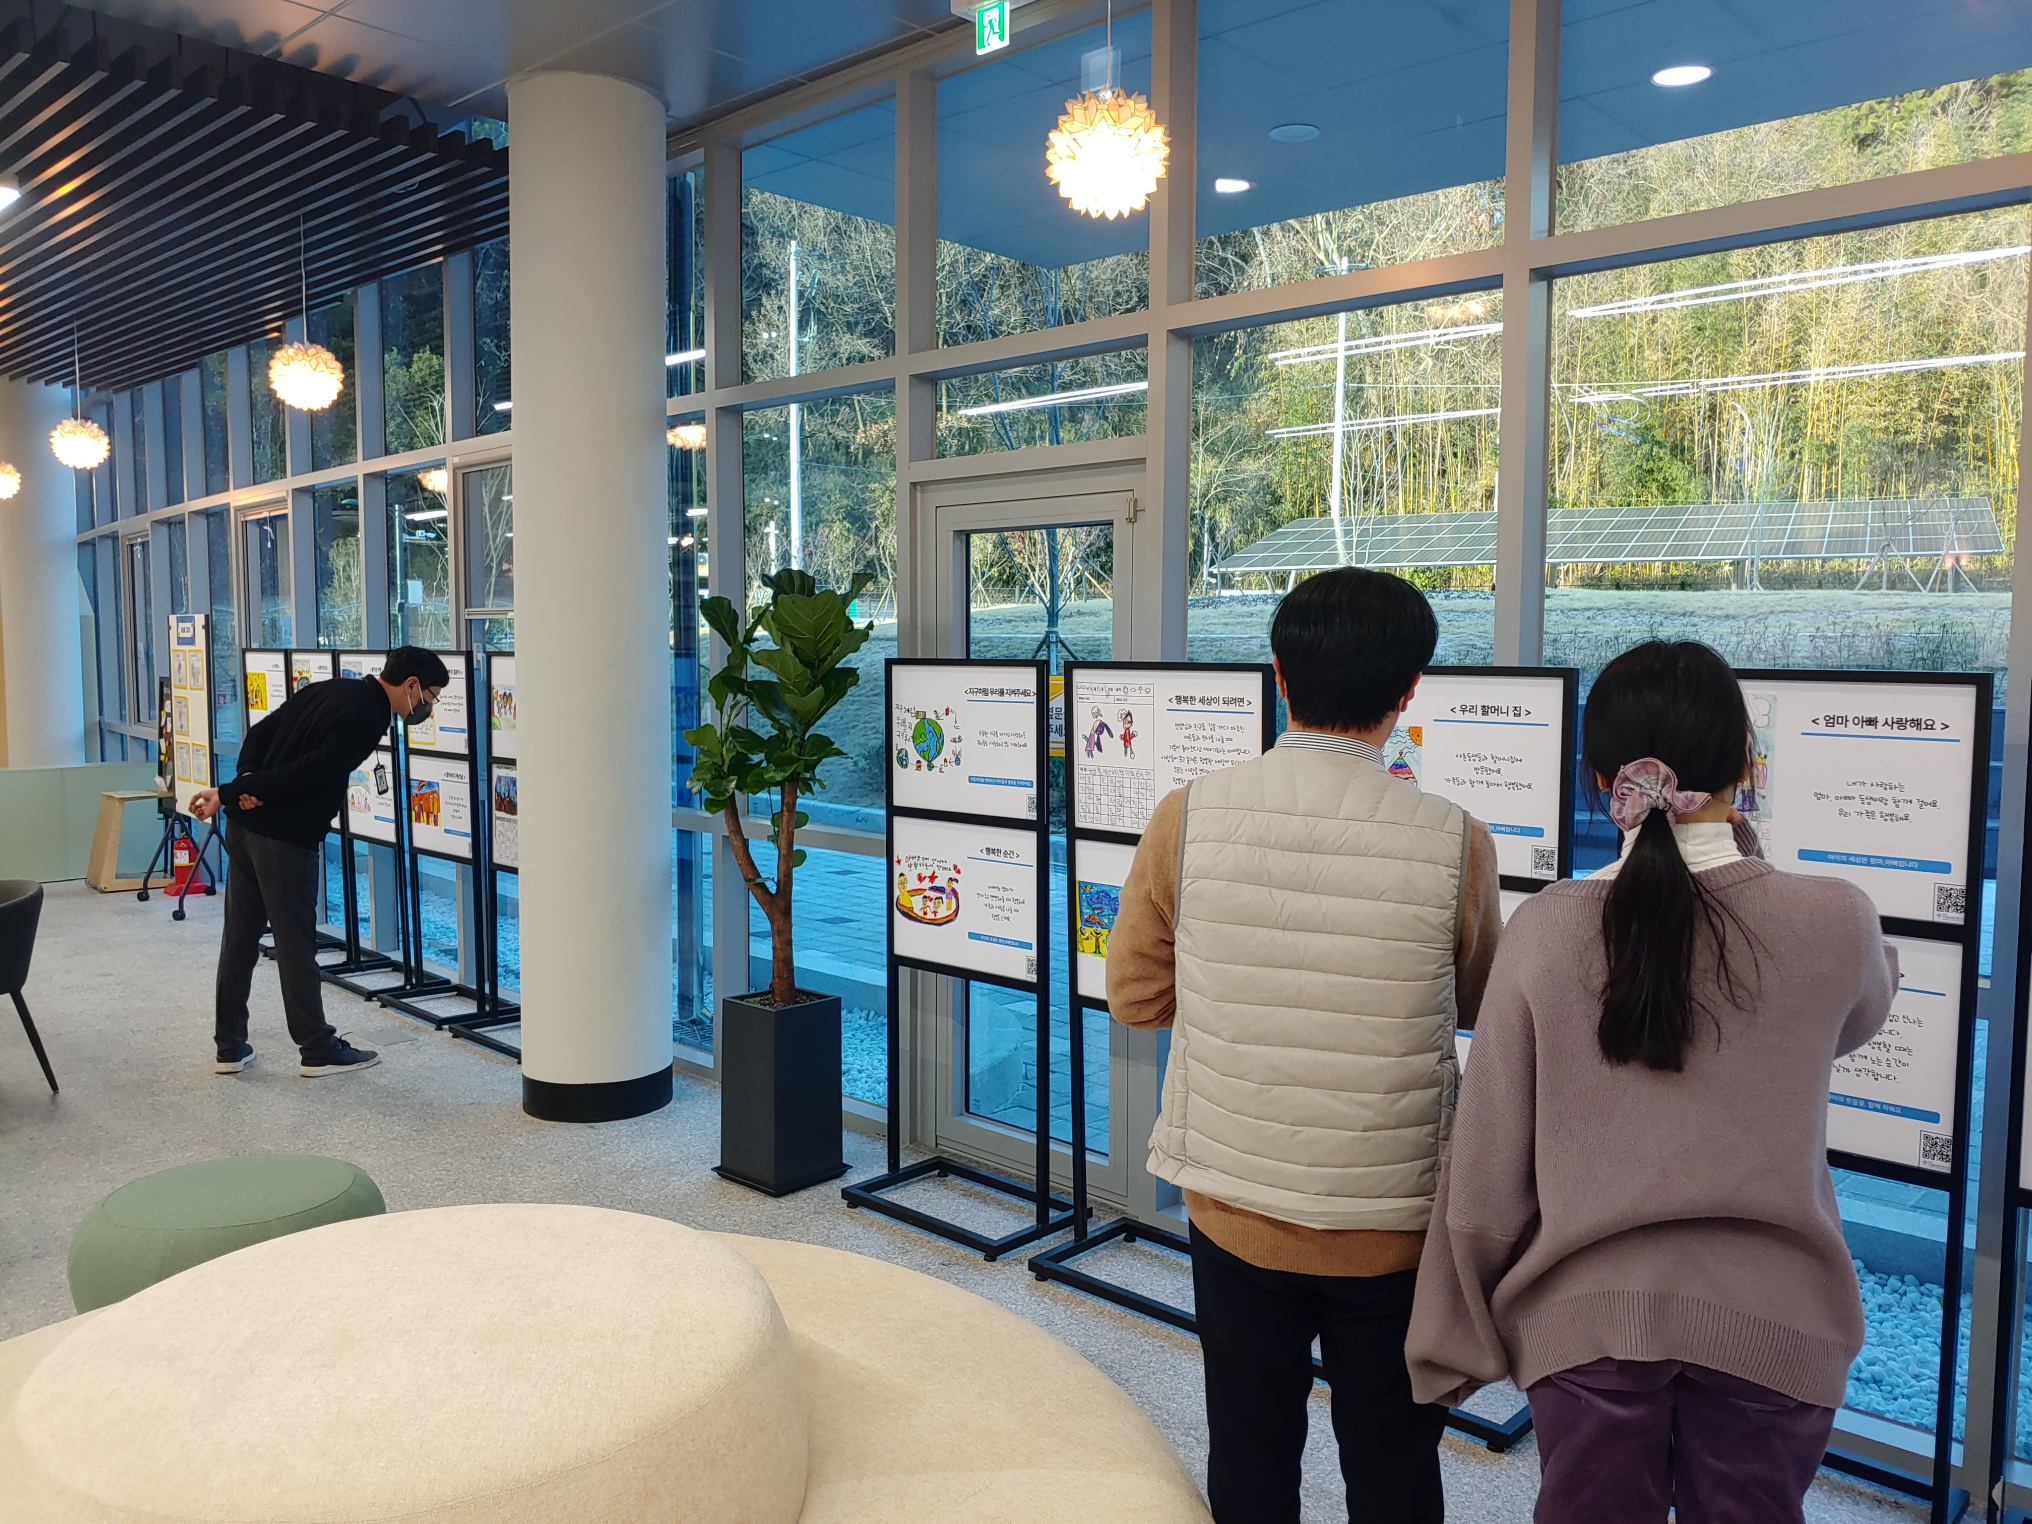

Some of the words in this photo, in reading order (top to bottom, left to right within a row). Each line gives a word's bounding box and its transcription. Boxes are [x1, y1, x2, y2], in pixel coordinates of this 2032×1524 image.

[989, 687, 1005, 697] 우리를
[1174, 695, 1197, 705] 행복한
[1198, 695, 1220, 706] 세상이
[1222, 696, 1245, 708] 되려면
[1459, 704, 1478, 716] 우리
[1480, 704, 1509, 717] 할머니
[1512, 705, 1522, 718] 집
[1823, 714, 1849, 728] 엄마
[1852, 715, 1879, 729] 아빠
[1881, 716, 1937, 731] 사랑해요
[1490, 754, 1523, 764] 할머니집에
[1444, 777, 1467, 787] 가족들과
[1468, 778, 1484, 789] 함께
[1846, 780, 1868, 788] 내가
[1870, 781, 1906, 793] 사랑하는
[1858, 794, 1889, 806] 동생이랑
[1891, 796, 1913, 808] 함께
[1837, 808, 1851, 818] 우리
[1854, 809, 1877, 820] 가족은
[1489, 825, 1521, 834] 마,아빠입니다
[985, 847, 1002, 858] 행복한
[1003, 849, 1015, 859] 순간
[1888, 1013, 1900, 1023] 겁고
[1902, 1013, 1924, 1028] 신나는
[1867, 1040, 1892, 1053] 행복할
[1894, 1045, 1914, 1057] 때는
[1870, 1056, 1883, 1067] 노는
[1885, 1057, 1910, 1068] 순간이
[1853, 1066, 1900, 1084] 생각합니다.
